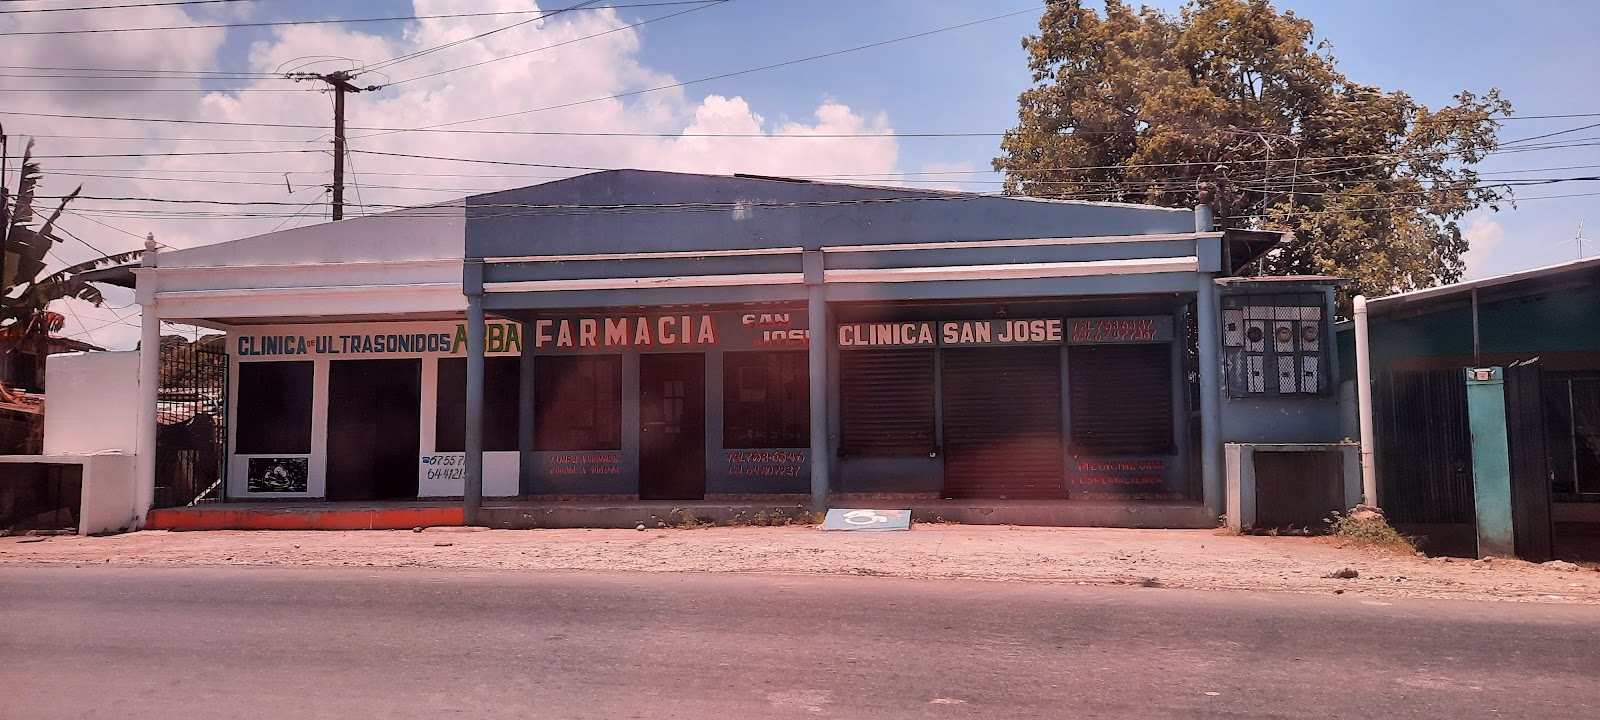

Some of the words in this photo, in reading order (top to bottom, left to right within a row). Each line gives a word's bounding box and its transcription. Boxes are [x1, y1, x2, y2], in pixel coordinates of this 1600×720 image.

[535, 314, 718, 349] FARMACIA
[742, 313, 791, 328] SAN
[838, 321, 934, 347] CLINICA
[943, 320, 992, 345] SAN
[998, 319, 1063, 343] JOSE
[238, 335, 307, 356] CLINICA
[315, 333, 451, 354] ULTRASONIDOS
[450, 323, 522, 354] ABA
